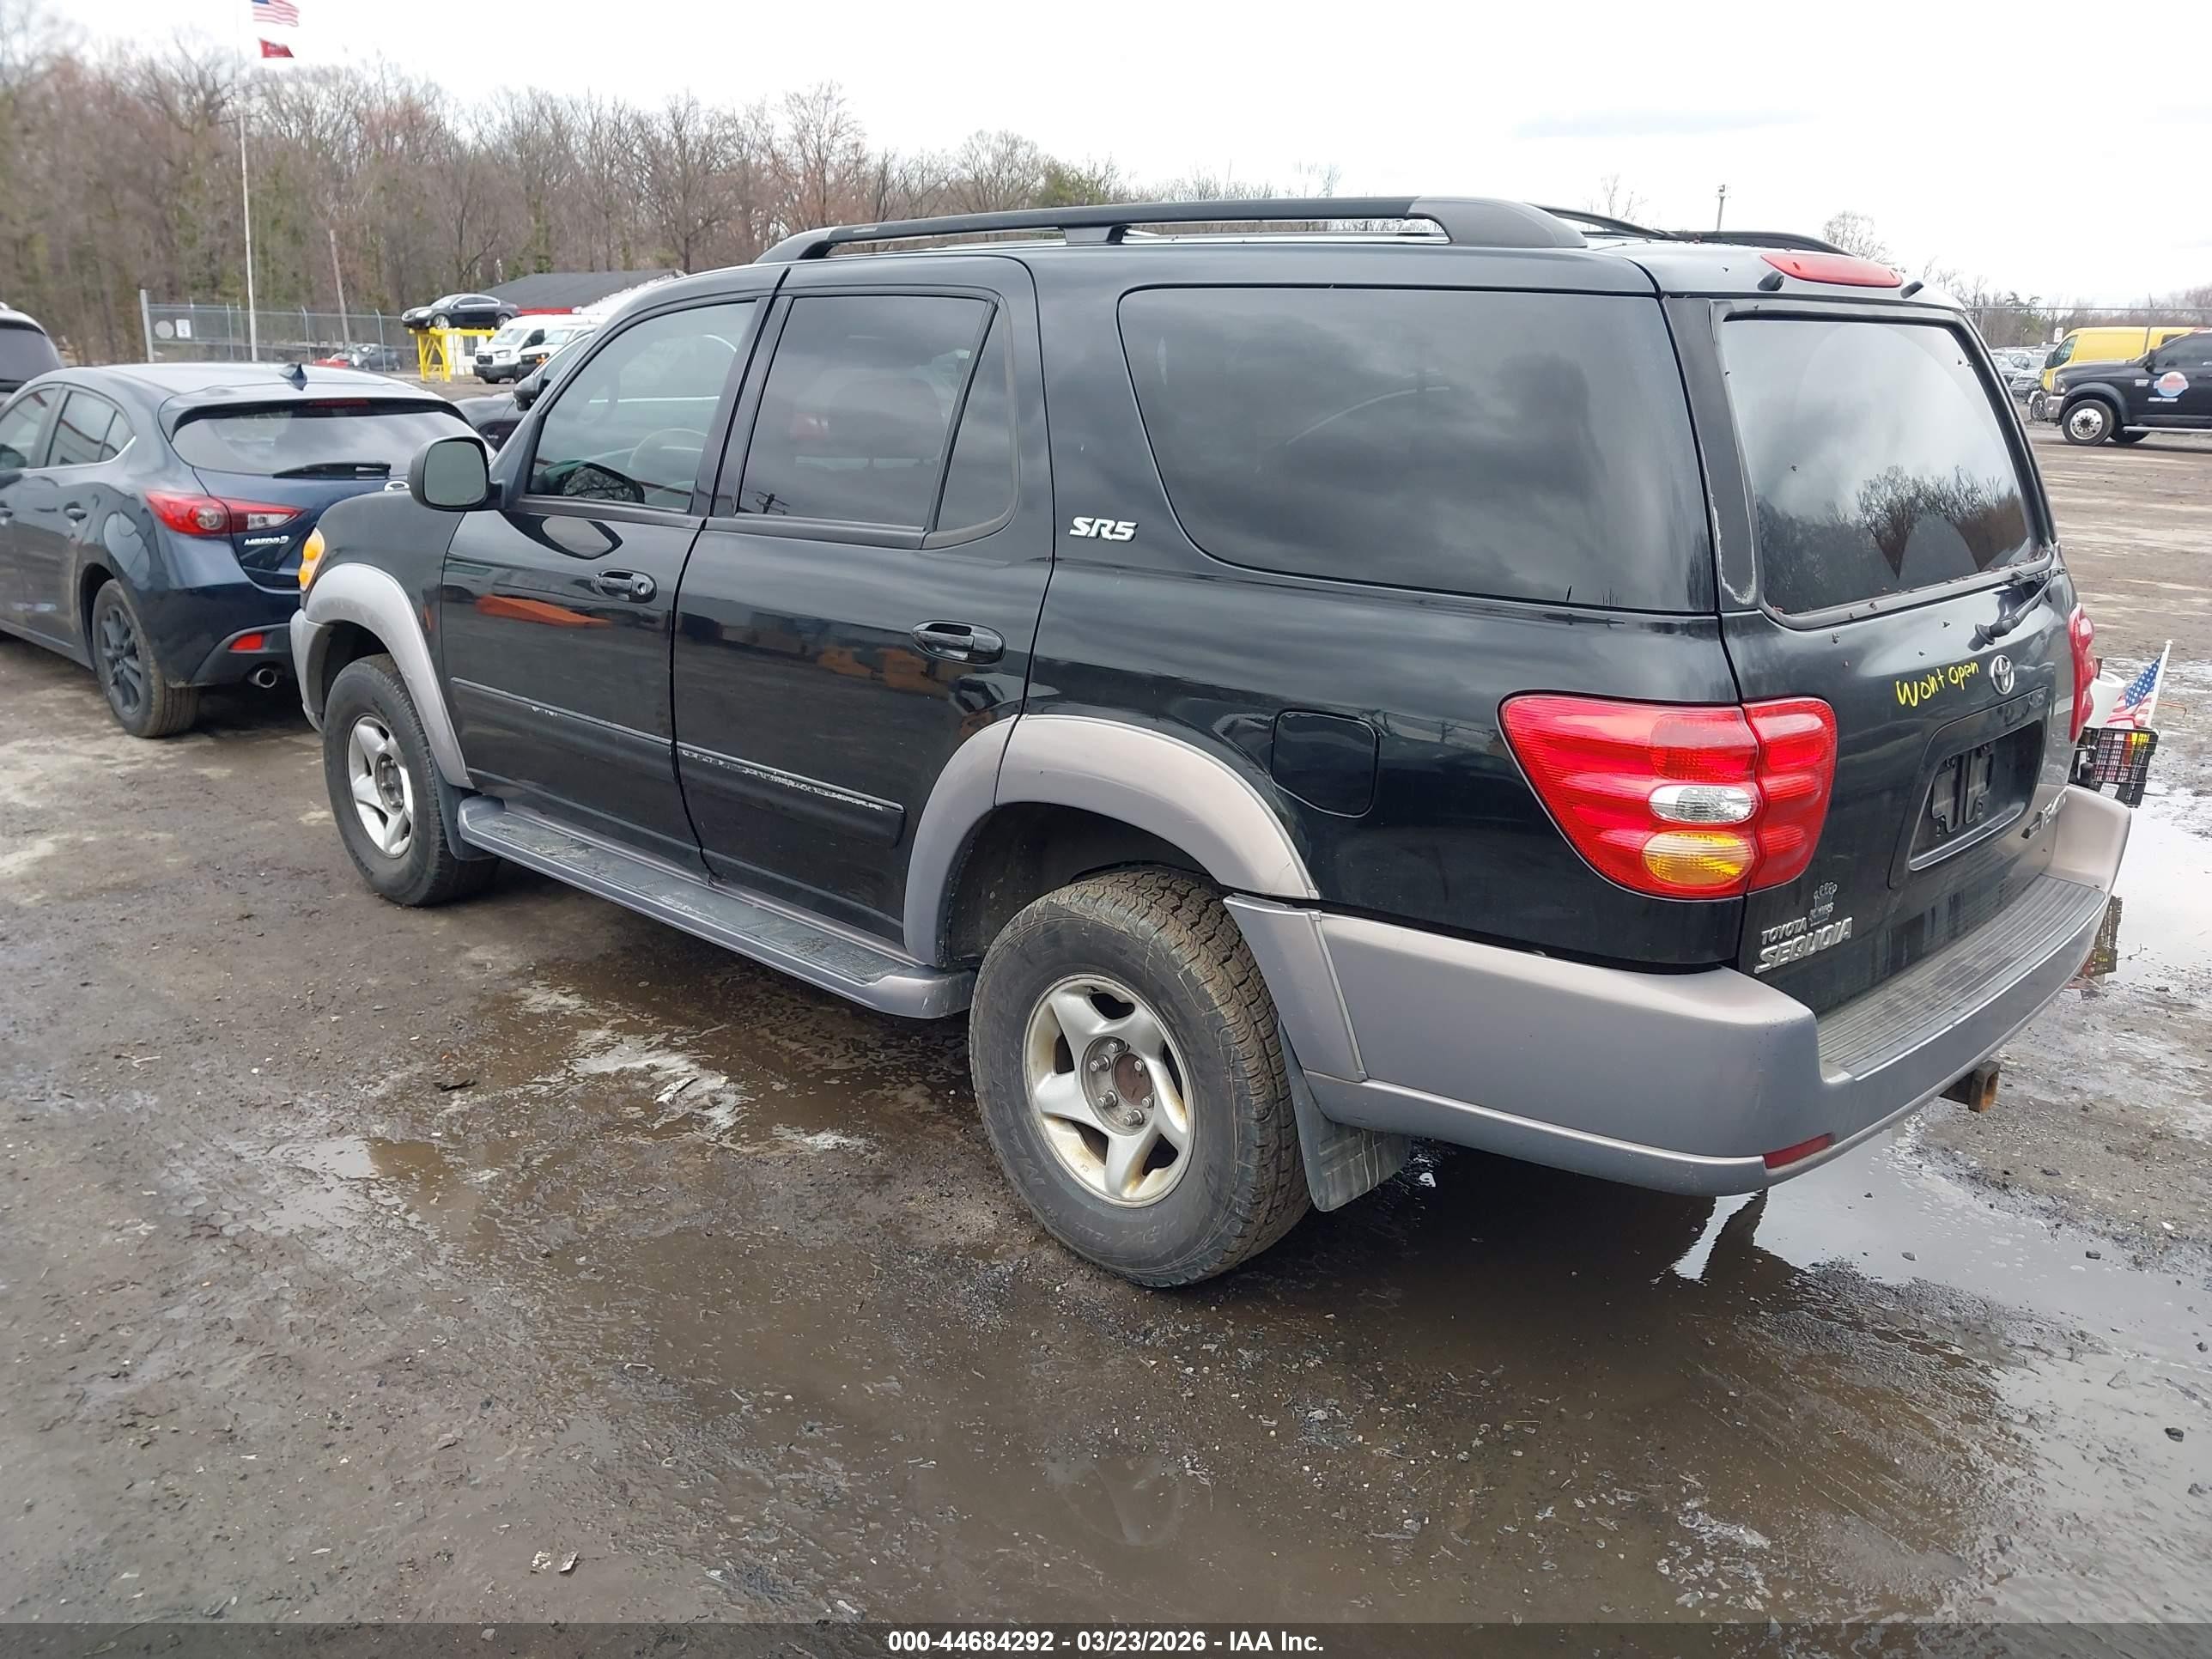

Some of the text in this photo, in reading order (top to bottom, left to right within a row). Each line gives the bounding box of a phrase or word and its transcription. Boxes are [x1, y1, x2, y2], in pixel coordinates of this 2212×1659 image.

[1069, 516, 1138, 541] SR5
[1761, 917, 1808, 945] TOYOTA
[1753, 916, 1853, 975] SEQUOIA
